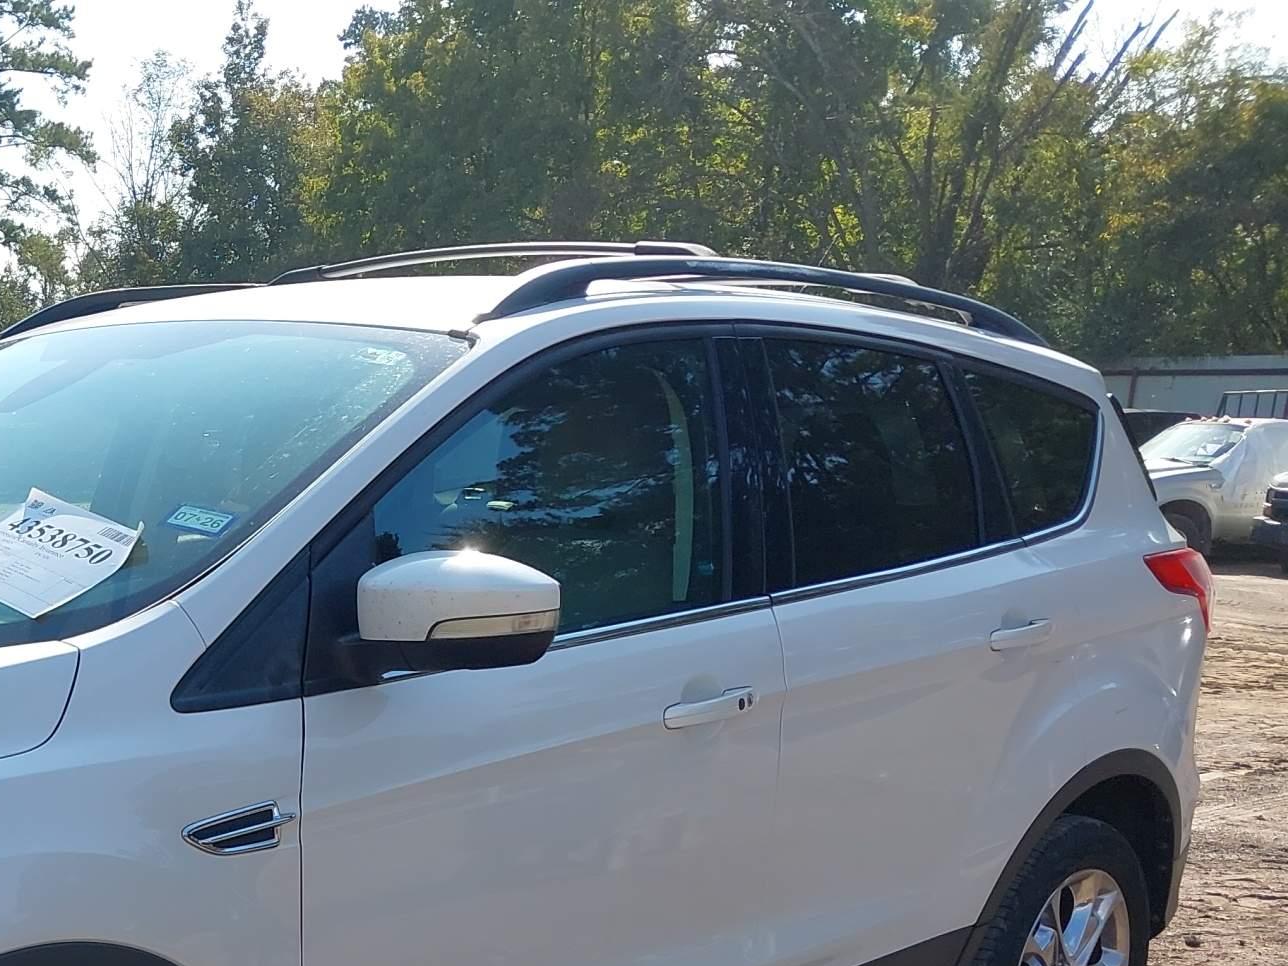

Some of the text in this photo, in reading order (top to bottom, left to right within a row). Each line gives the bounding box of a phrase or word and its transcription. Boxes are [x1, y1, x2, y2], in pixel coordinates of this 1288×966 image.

[174, 511, 197, 522] 07
[200, 517, 224, 528] 26
[8, 517, 113, 565] 43538750
